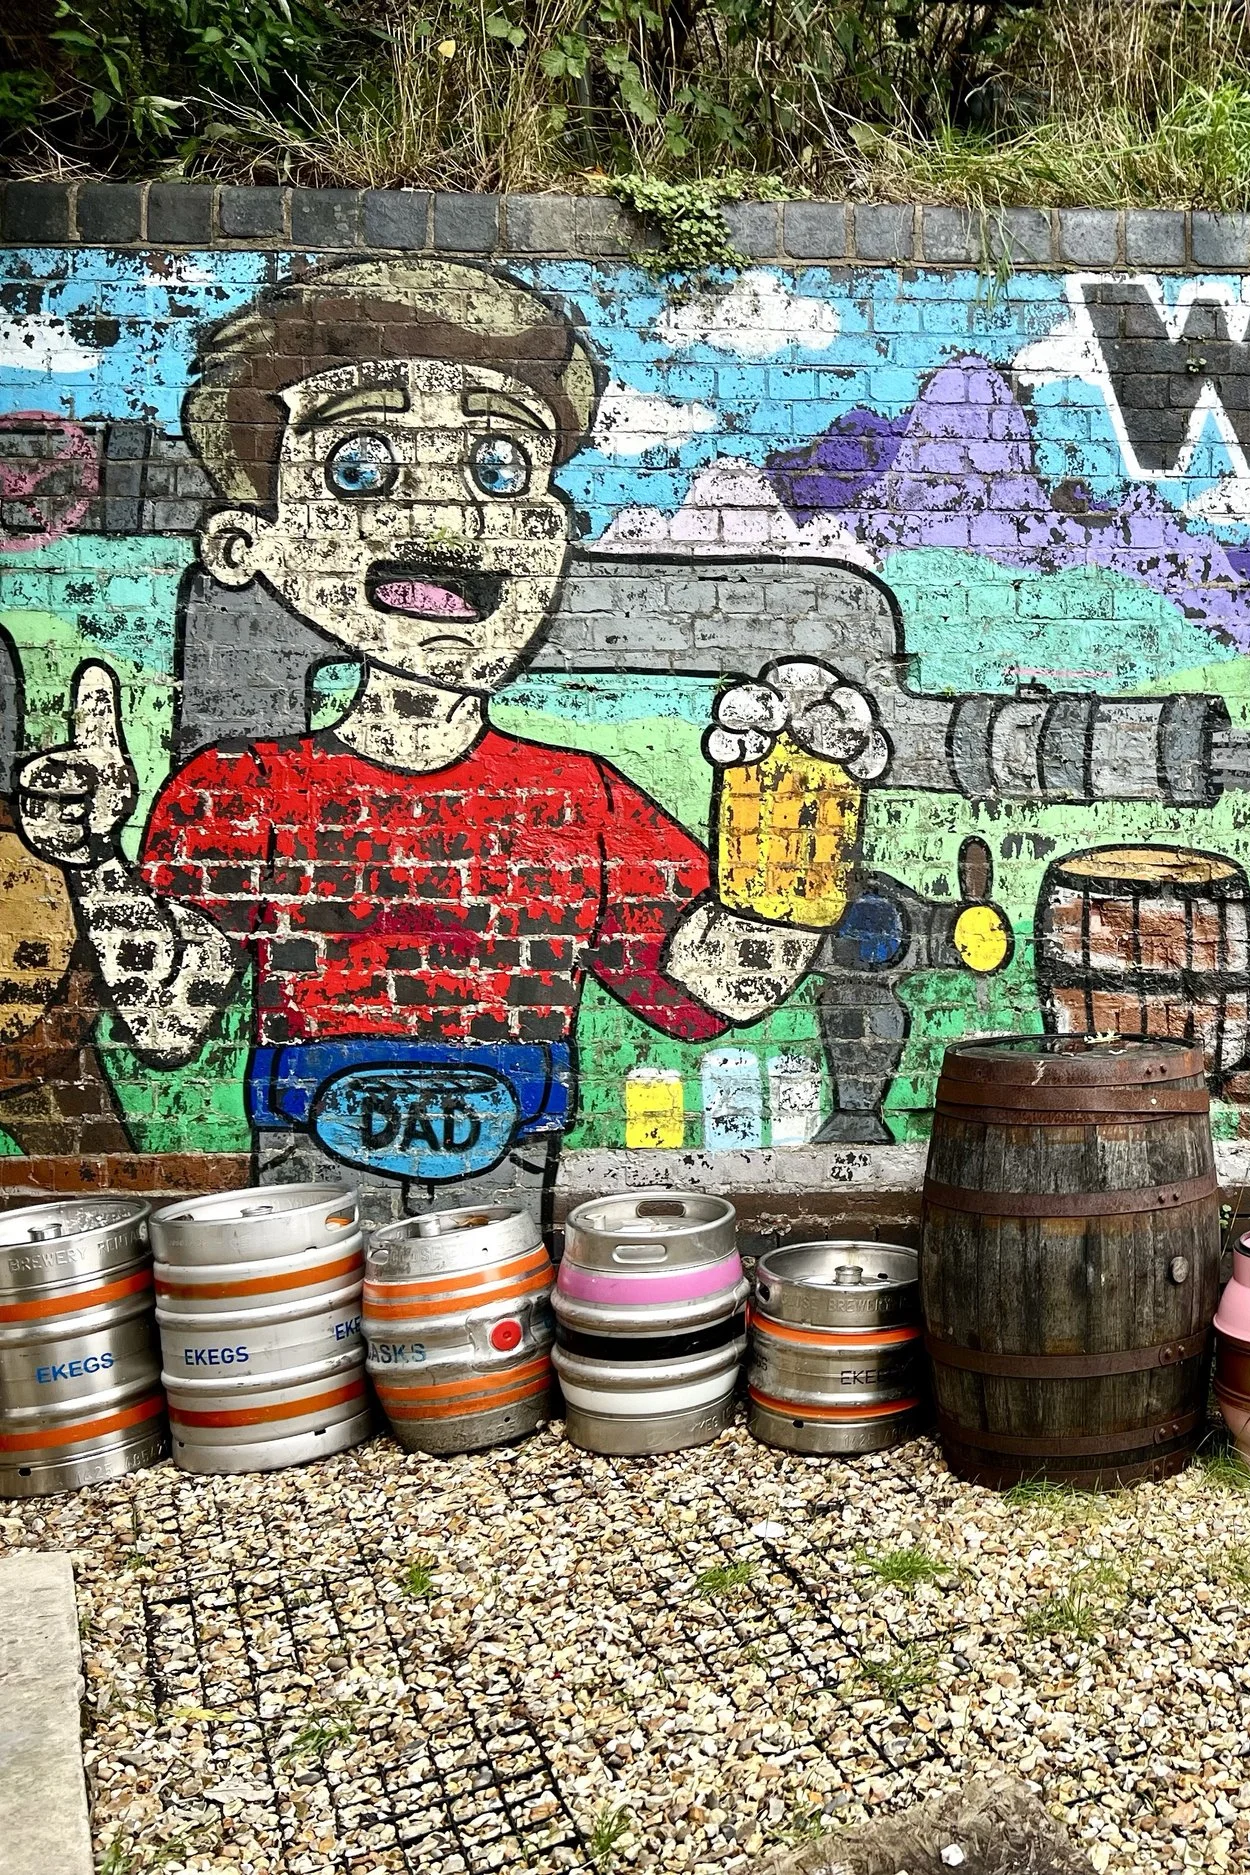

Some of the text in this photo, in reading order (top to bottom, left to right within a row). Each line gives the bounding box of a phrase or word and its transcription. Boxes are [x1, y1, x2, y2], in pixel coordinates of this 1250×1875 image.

[361, 1095, 481, 1153] DAD
[8, 1247, 88, 1272] BREWERY
[334, 1316, 361, 1341] EKE
[36, 1352, 115, 1384] EKEGS
[184, 1345, 250, 1366] EKEGS
